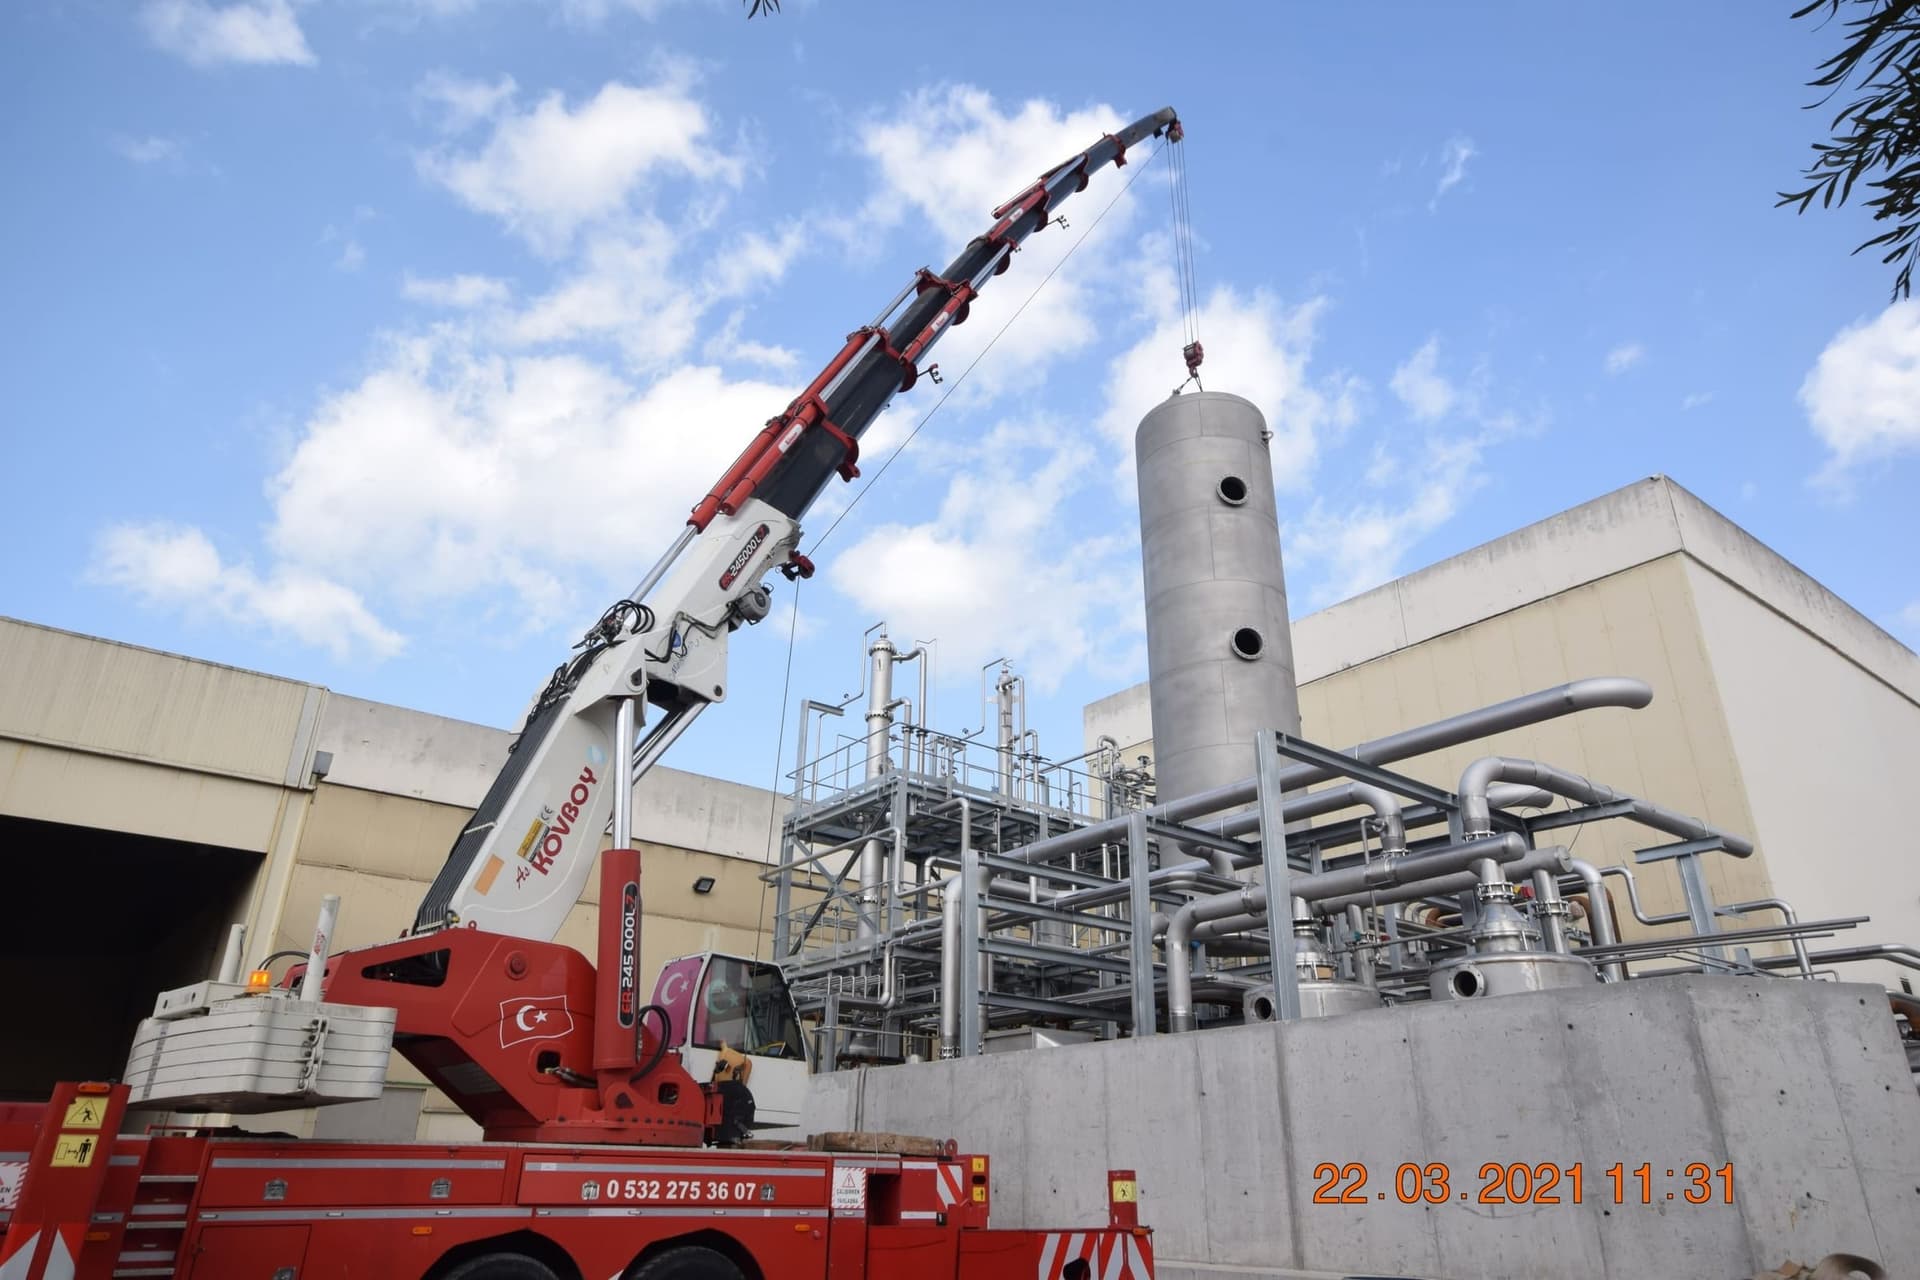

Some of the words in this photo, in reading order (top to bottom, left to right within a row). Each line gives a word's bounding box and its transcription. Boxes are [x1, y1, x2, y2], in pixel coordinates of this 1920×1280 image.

[531, 766, 597, 876] KOVBOY
[606, 1179, 620, 1199] 0
[624, 1180, 661, 1199] 532
[666, 1181, 701, 1200] 275
[706, 1182, 729, 1200] 36
[734, 1183, 757, 1201] 07
